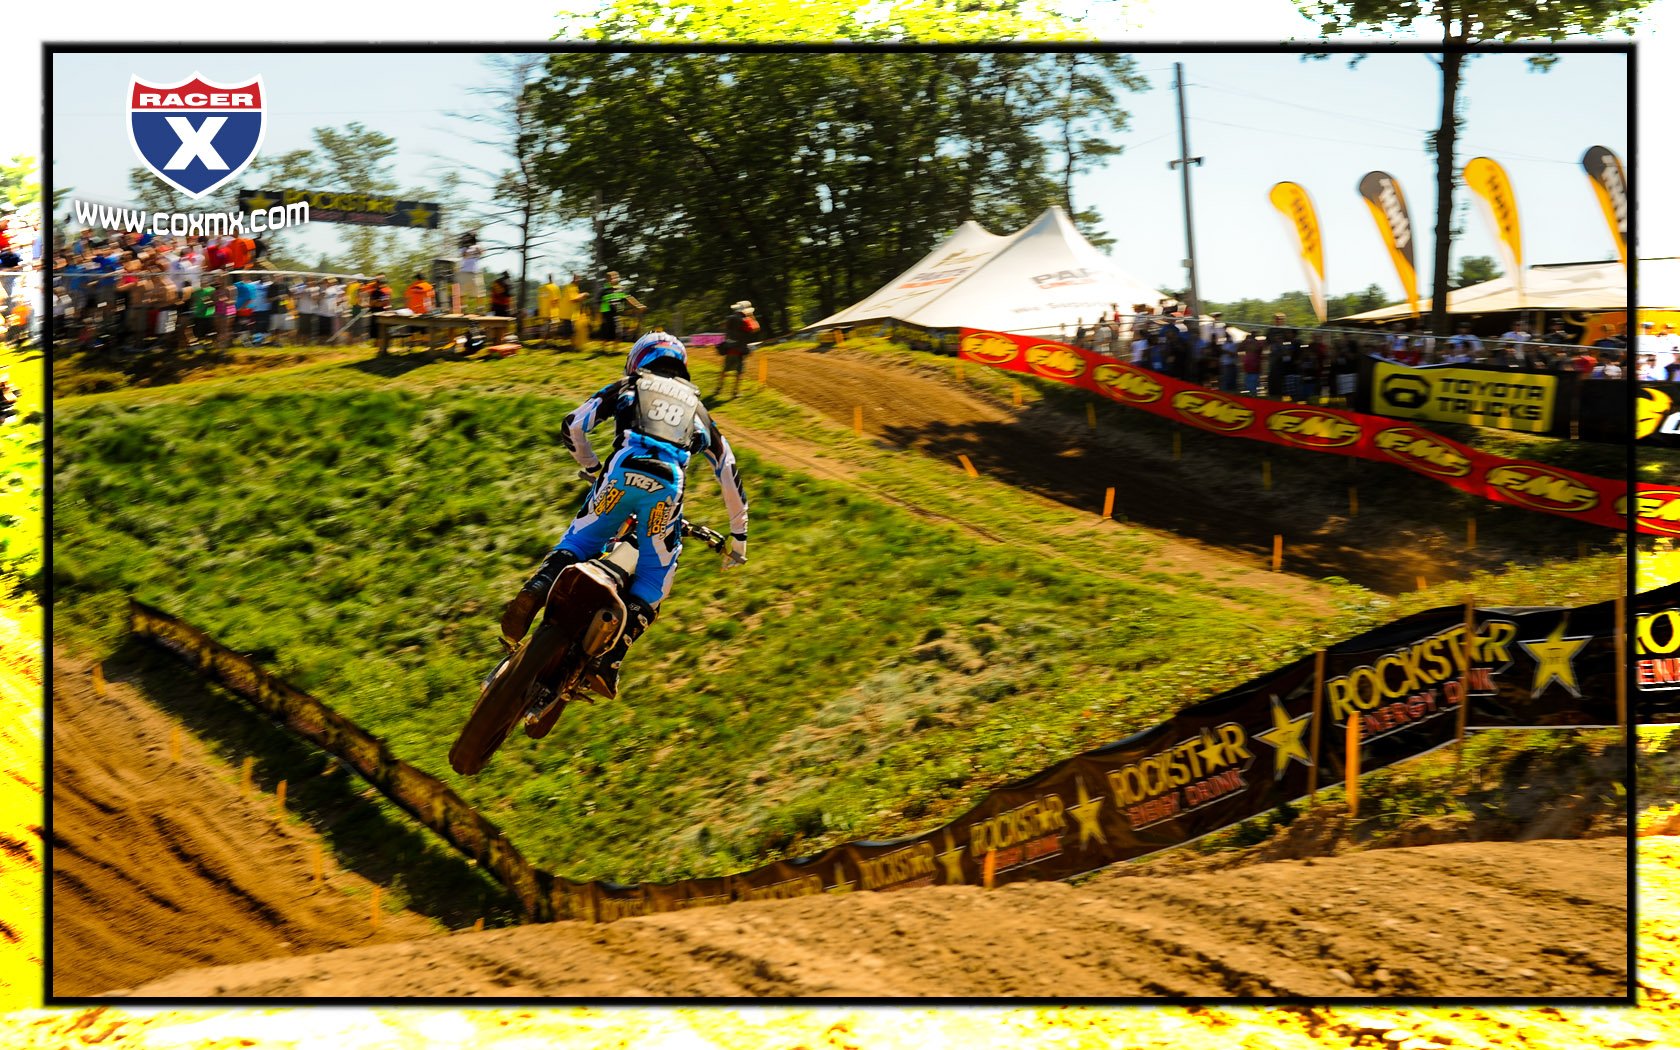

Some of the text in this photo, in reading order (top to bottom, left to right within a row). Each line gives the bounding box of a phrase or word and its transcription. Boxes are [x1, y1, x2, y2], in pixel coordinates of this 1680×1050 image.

[1440, 378, 1545, 400] TOYOTA
[648, 399, 684, 426] 38
[1173, 392, 1255, 425] FMF
[1437, 396, 1543, 420] TRUCKS
[1266, 411, 1362, 440] FMF
[1374, 430, 1472, 469] FMF
[624, 472, 665, 493] TREY
[1486, 466, 1600, 503] FMF
[1443, 667, 1497, 704] DNK
[1108, 724, 1252, 808] ROCKSTAR
